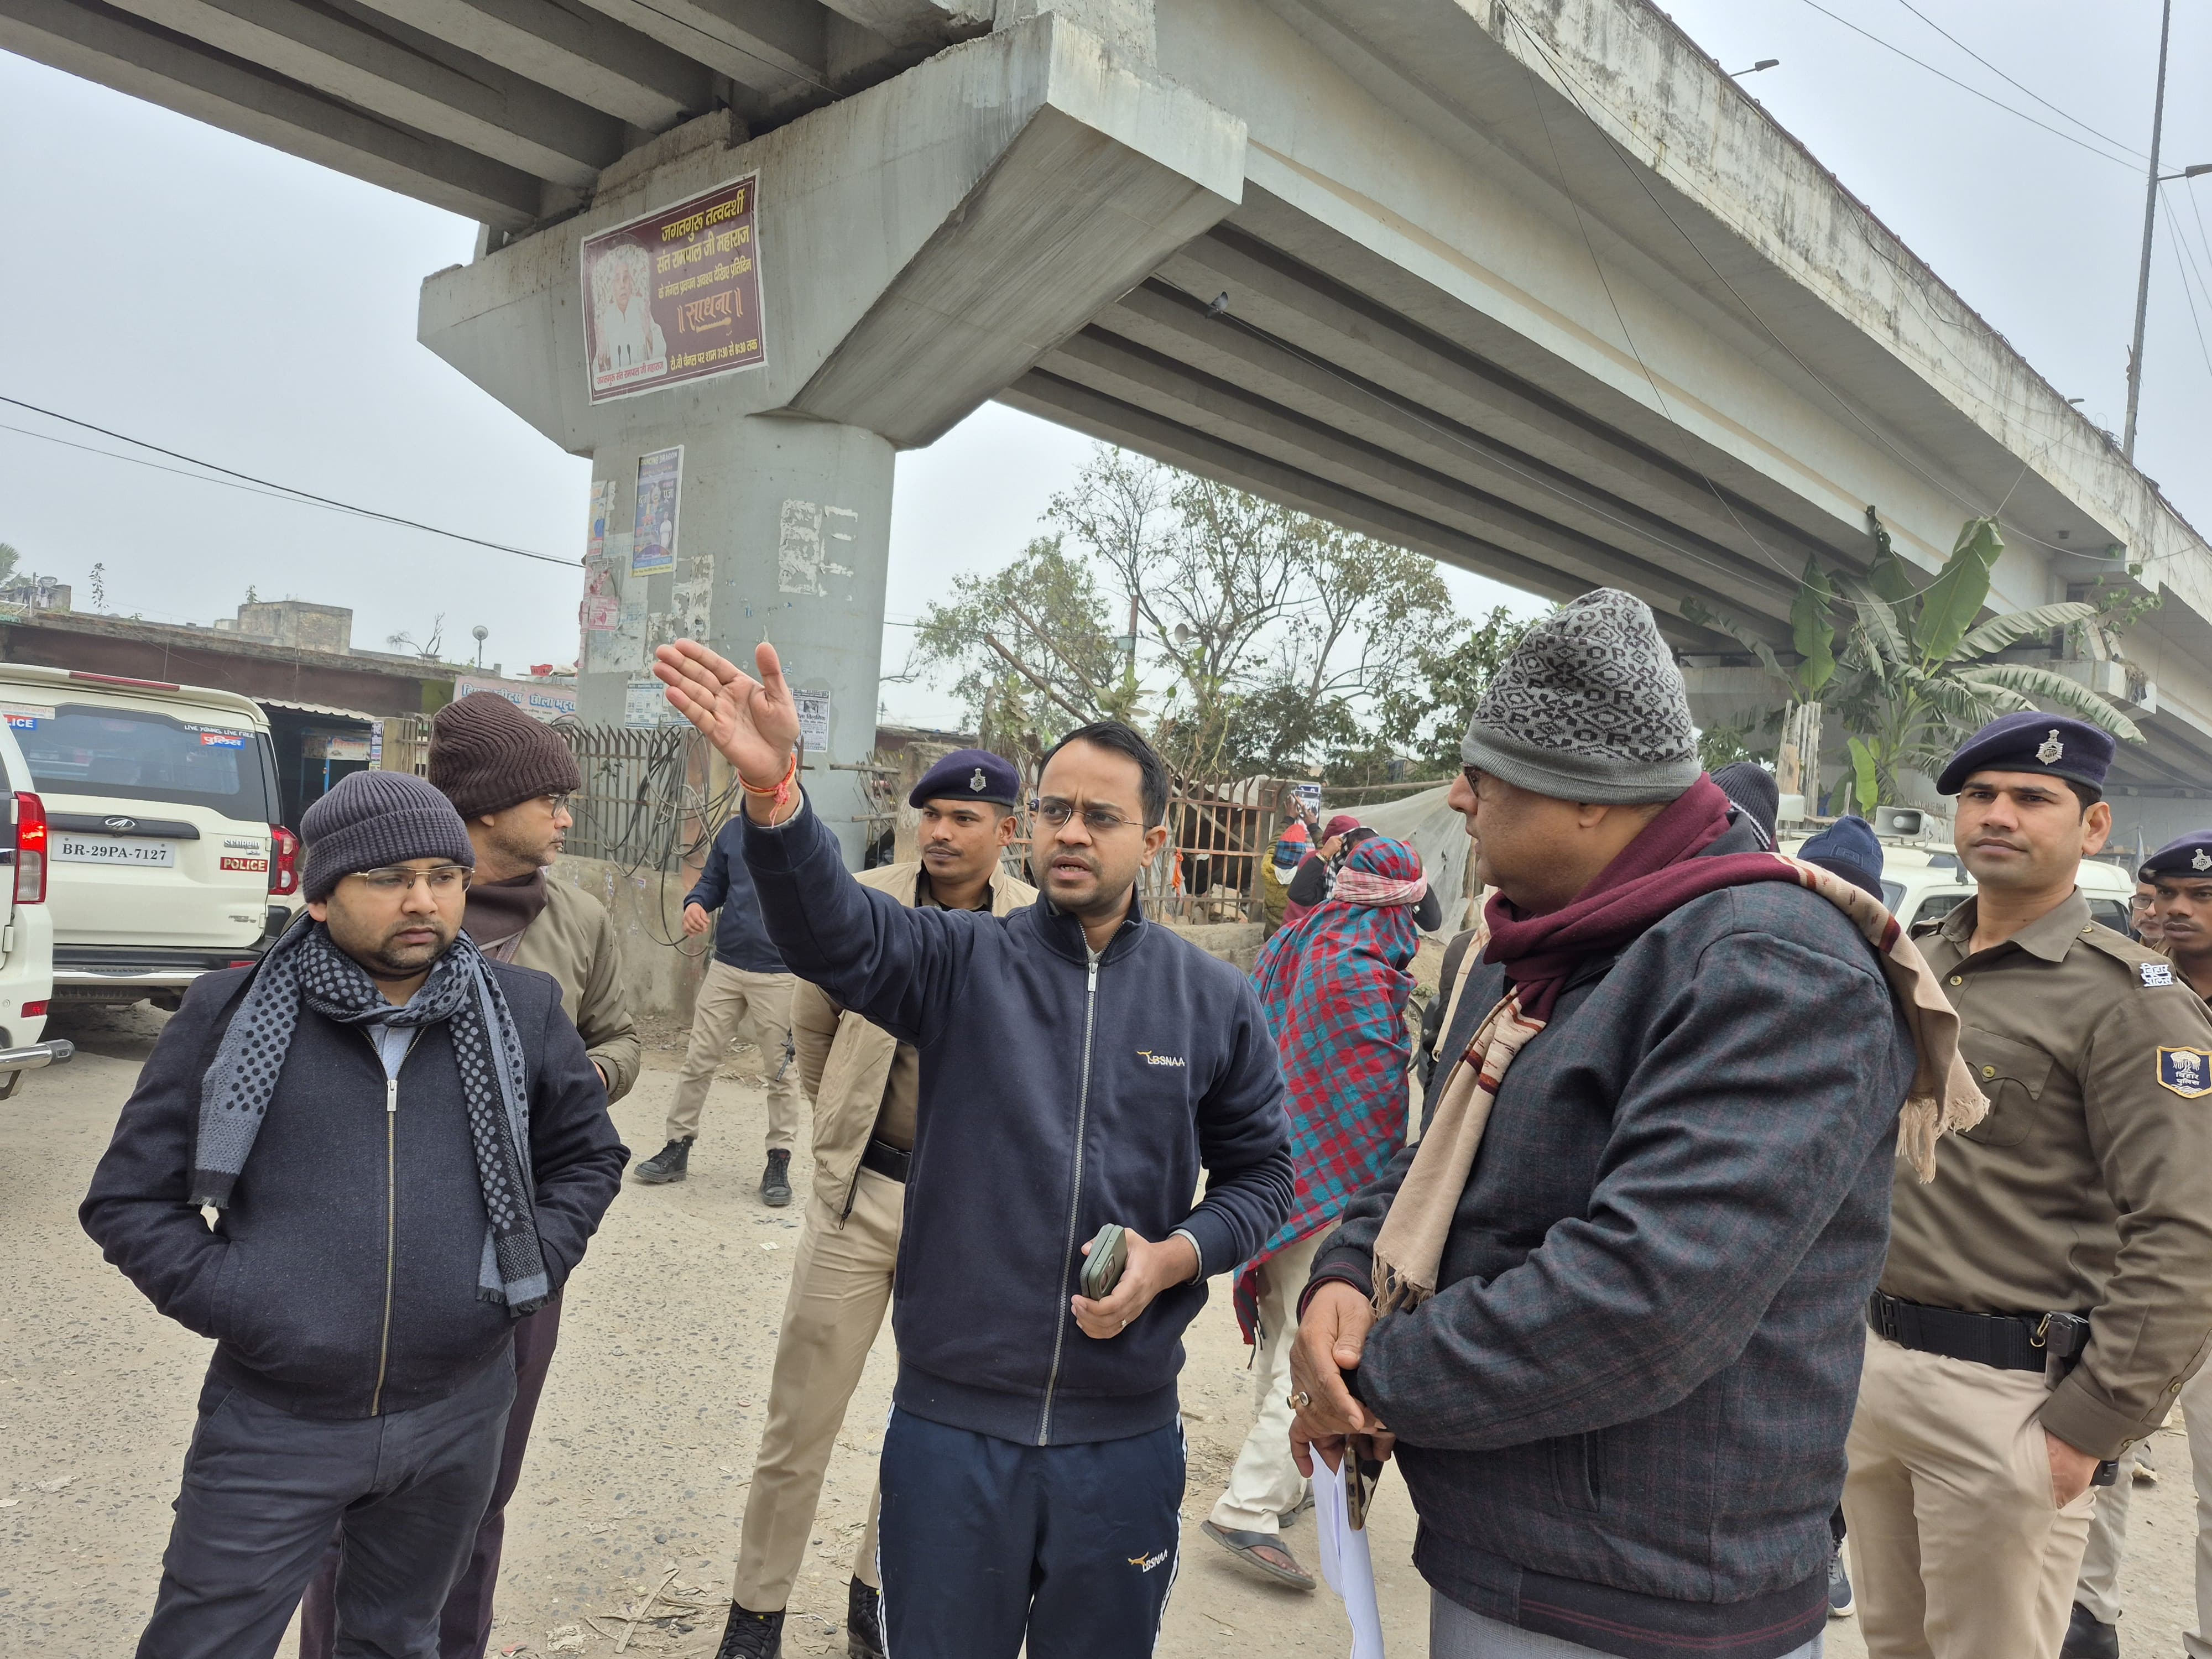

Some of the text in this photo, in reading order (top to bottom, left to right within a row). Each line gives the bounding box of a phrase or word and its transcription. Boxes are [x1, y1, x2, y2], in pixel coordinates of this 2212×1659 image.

[656, 225, 749, 274] संत रामपाल जी महाराज
[658, 283, 664, 299] के
[665, 281, 679, 297] मंगल
[697, 271, 713, 288] अवश्य
[731, 255, 752, 279] प्रतिदिन
[685, 290, 733, 331] साधना
[697, 352, 705, 363] पर
[706, 349, 717, 362] शाम
[729, 341, 735, 356] से
[747, 338, 758, 352] तक
[640, 362, 646, 374] जी
[203, 735, 242, 746] पुलिस
[61, 843, 167, 860] BR-29PA-7127
[223, 858, 265, 871] POLICE
[1147, 1055, 1185, 1067] LBSNAA
[2176, 1071, 2199, 1080] बिहार
[2176, 1078, 2200, 1086] पुलिस
